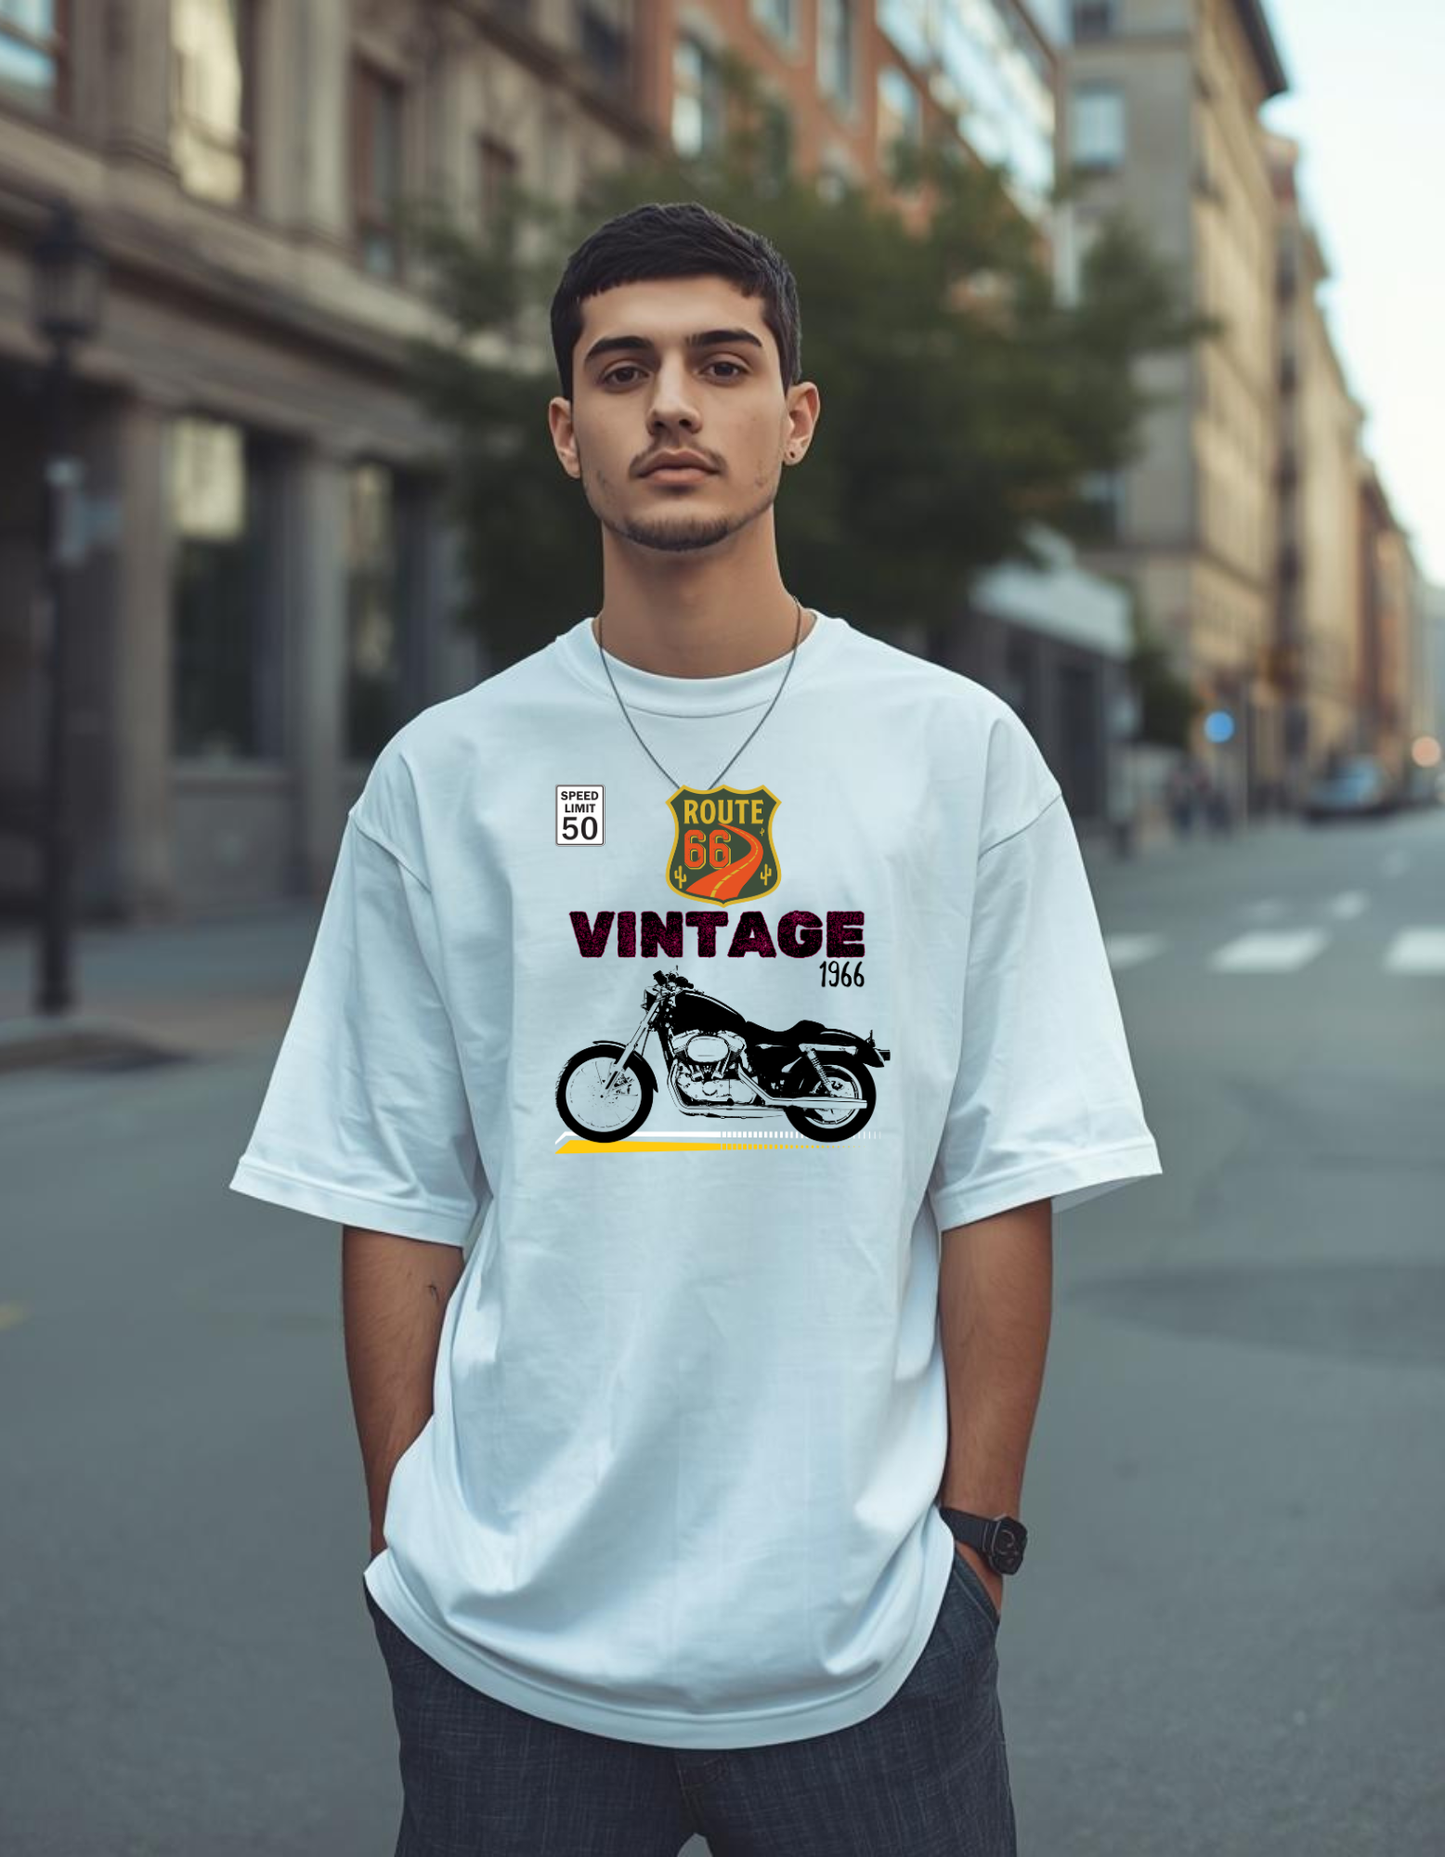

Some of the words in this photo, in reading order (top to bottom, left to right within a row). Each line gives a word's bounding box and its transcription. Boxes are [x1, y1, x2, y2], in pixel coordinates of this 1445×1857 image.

[561, 790, 599, 801] SPEED
[564, 803, 596, 813] LIMIT
[684, 799, 764, 824] ROUTE
[561, 816, 598, 841] 50
[684, 829, 731, 870] 66
[569, 910, 865, 958] VINTAGE
[819, 961, 865, 987] 1966
